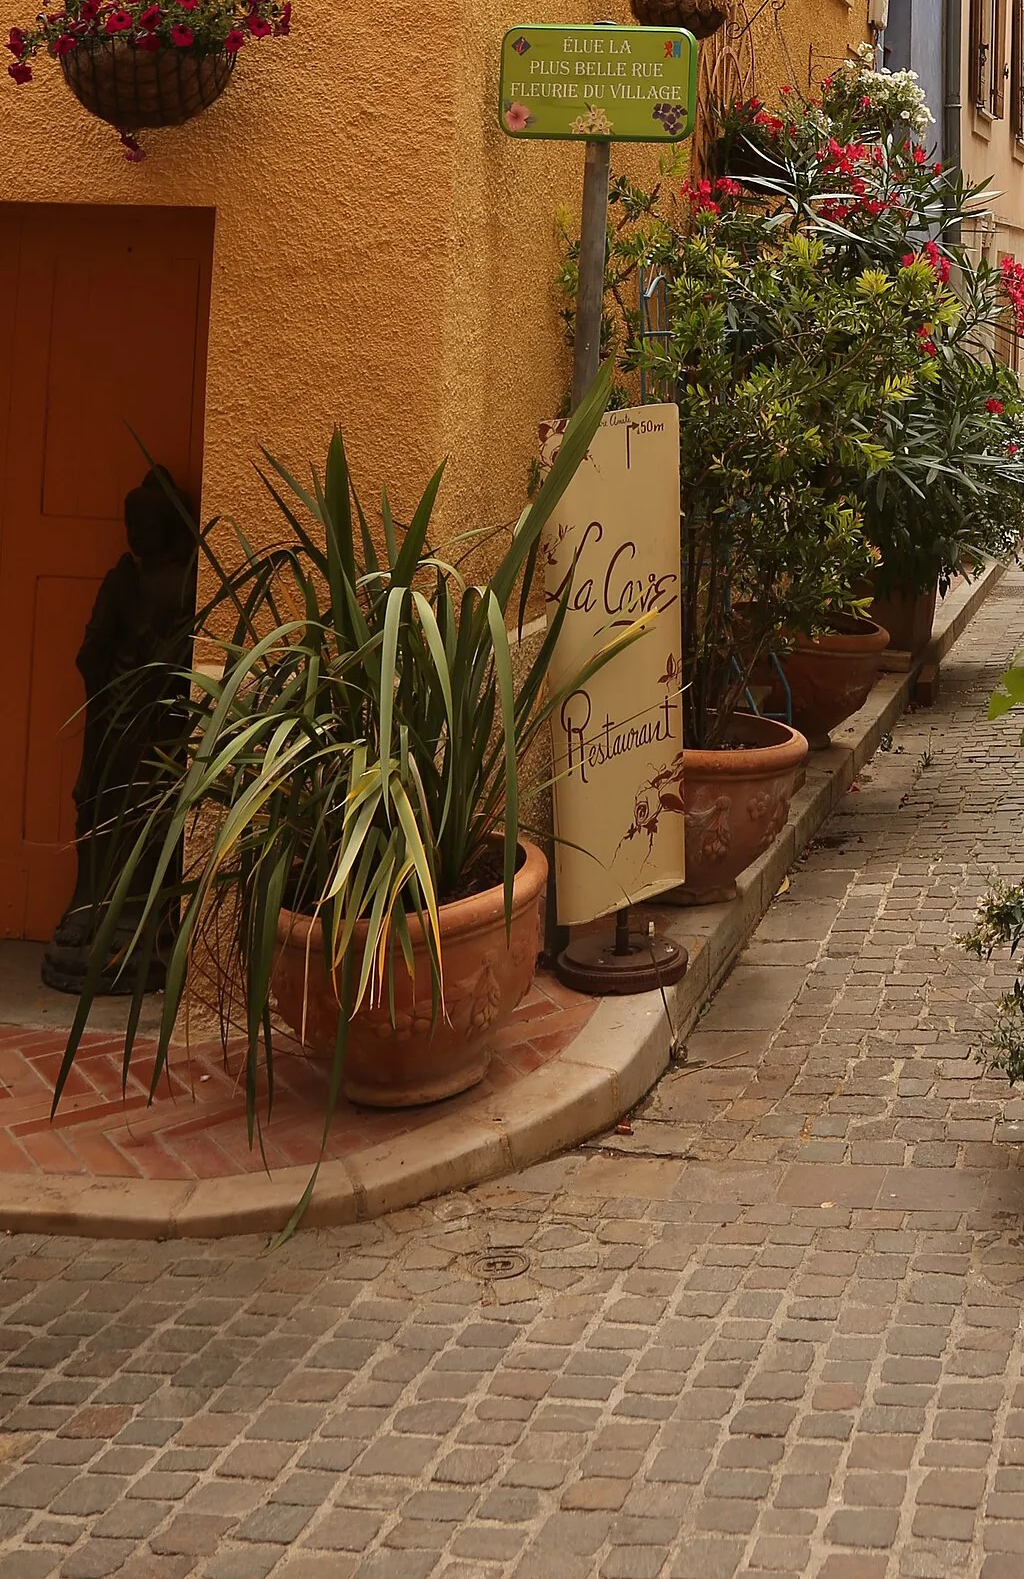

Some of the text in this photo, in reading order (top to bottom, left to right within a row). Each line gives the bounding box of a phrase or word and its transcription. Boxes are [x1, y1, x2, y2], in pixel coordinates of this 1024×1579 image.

[563, 36, 632, 54] ÉLUE LA
[530, 60, 664, 78] PLUS BELLE RUE
[510, 82, 682, 100] FLEURIE DU VILLAGE
[545, 521, 603, 613] La
[561, 689, 678, 784] Restaurant
